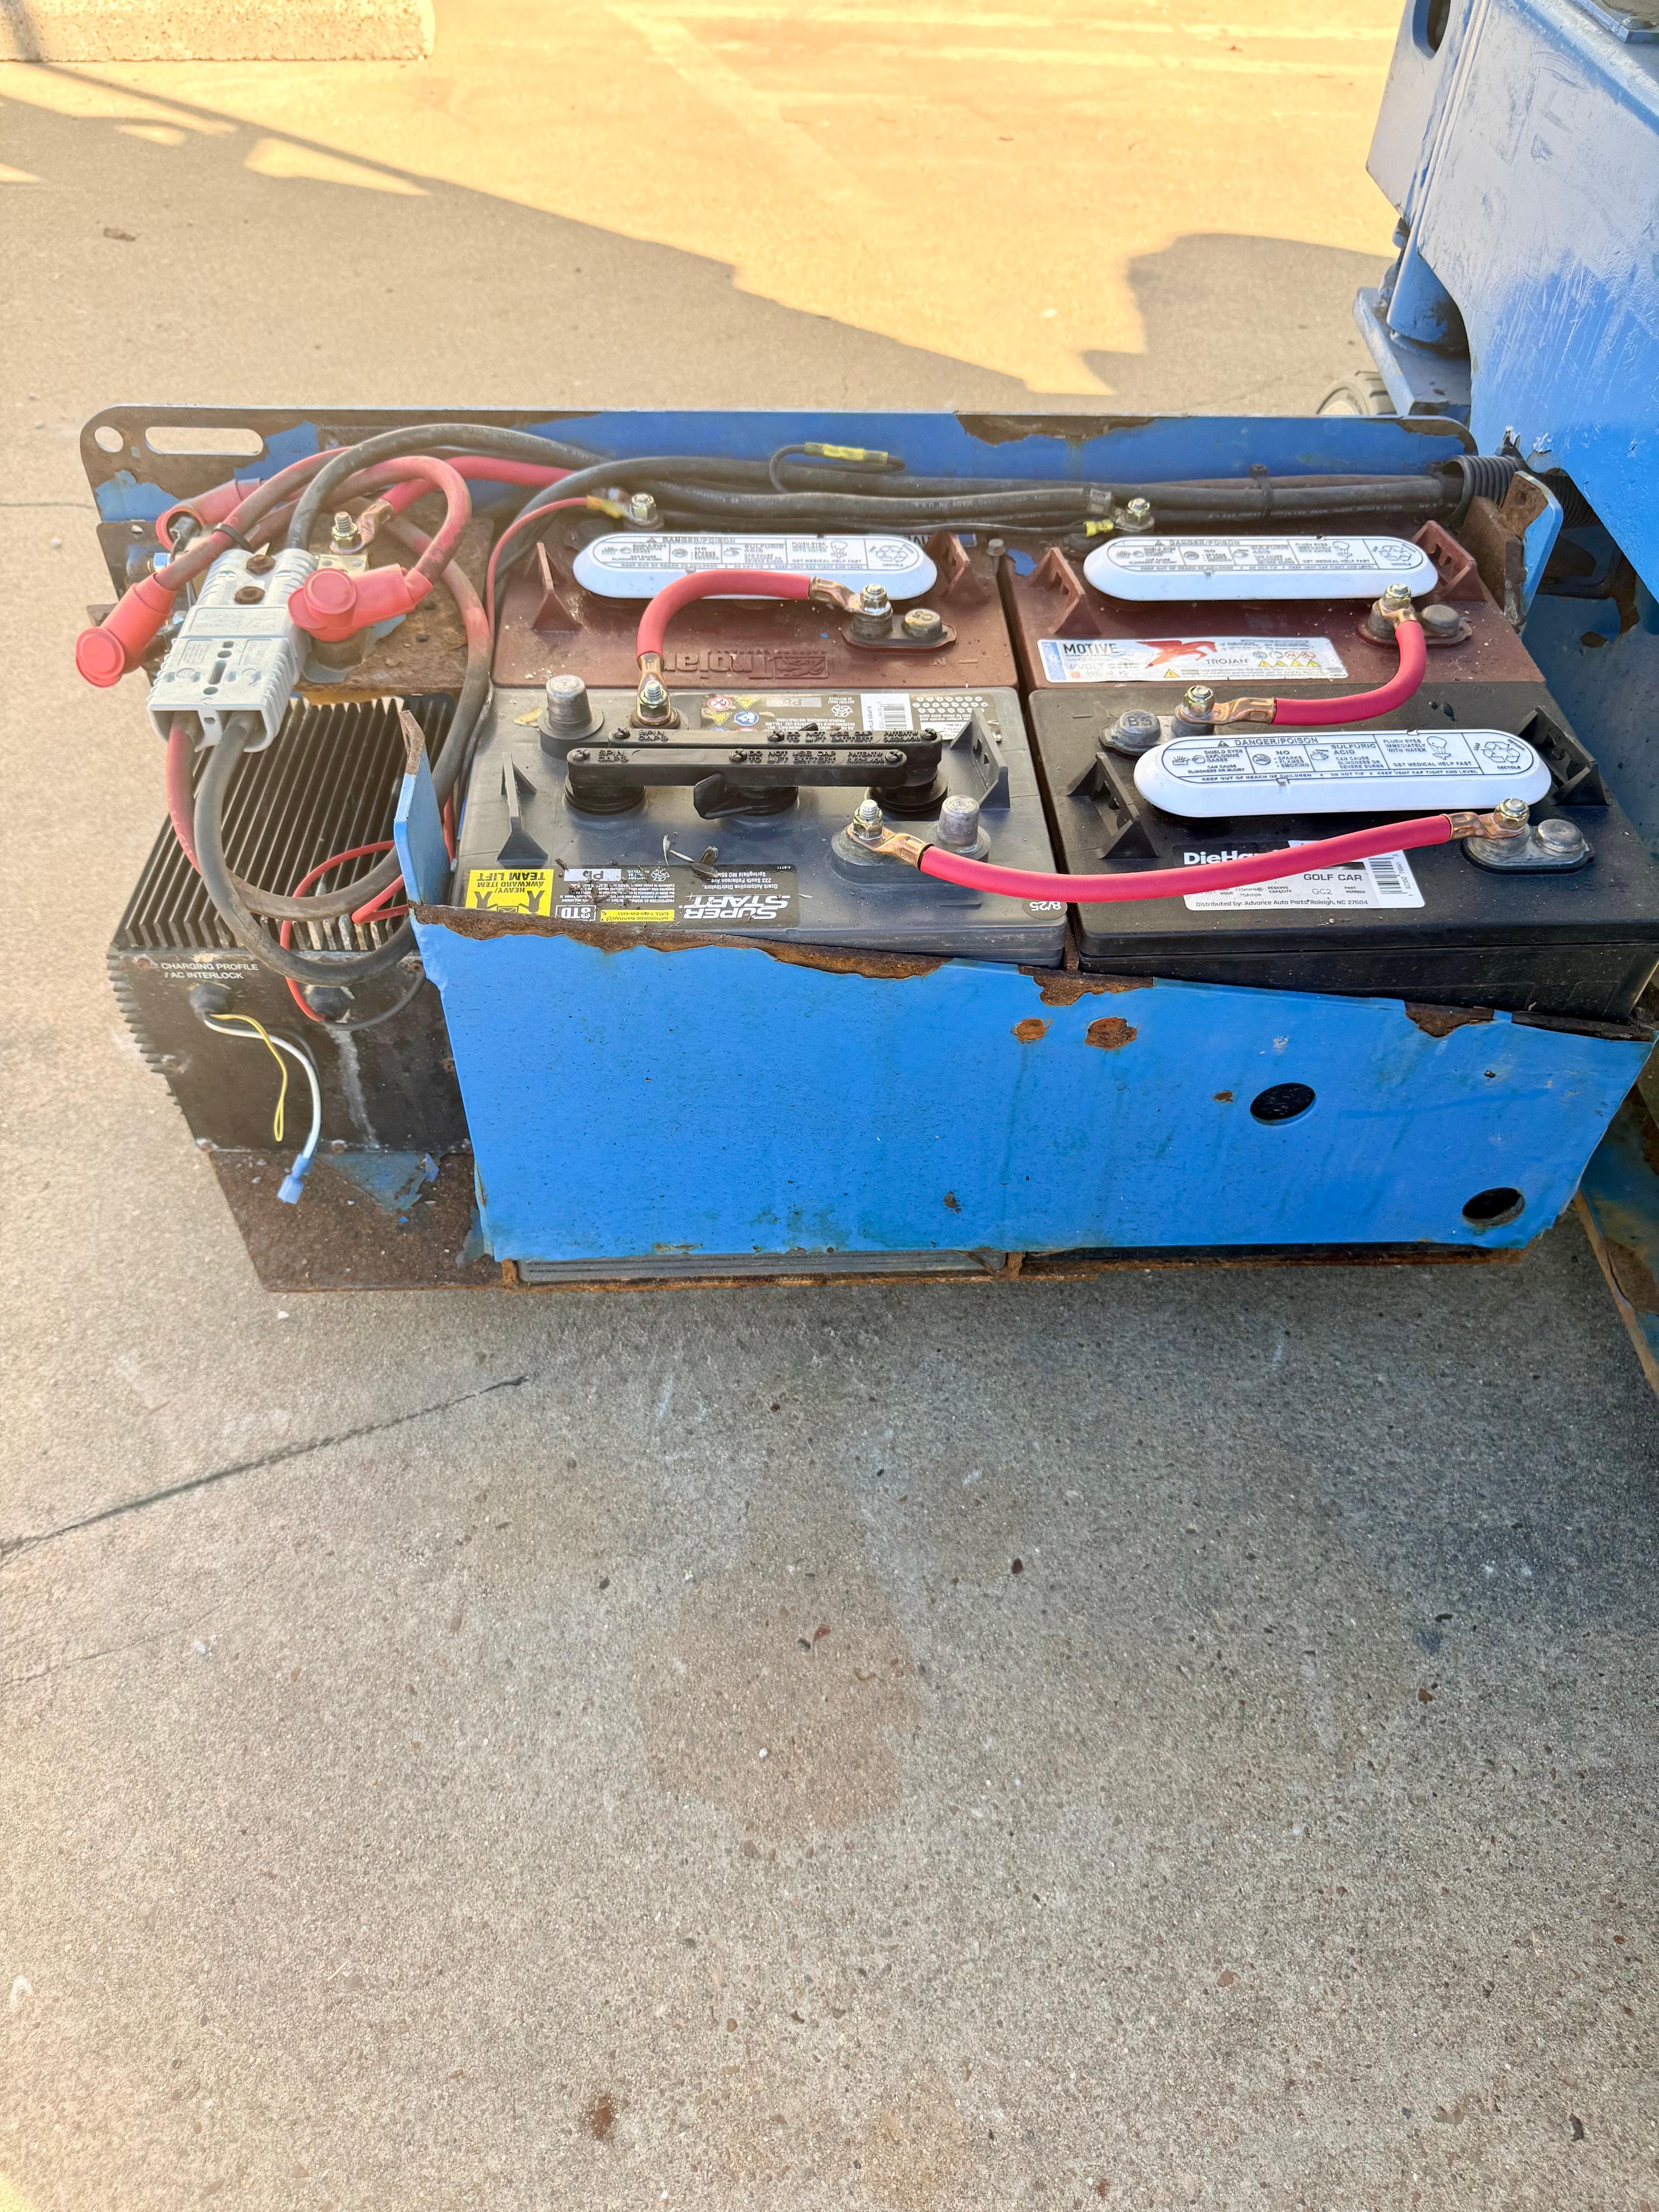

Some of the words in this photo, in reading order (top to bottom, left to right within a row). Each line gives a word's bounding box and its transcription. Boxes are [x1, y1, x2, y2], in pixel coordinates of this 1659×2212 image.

[1063, 643, 1119, 654] MOTIVE
[1234, 737, 1319, 746] DANGER/POISON
[793, 756, 836, 764] BATTERY
[1184, 850, 1280, 865] DieH
[477, 873, 505, 881] LIFT
[509, 872, 546, 880] TEAM
[582, 870, 604, 880] Pb
[684, 895, 791, 908] START
[1029, 901, 1062, 911] 8/25
[561, 907, 591, 918] STD
[684, 907, 778, 920] SUPER
